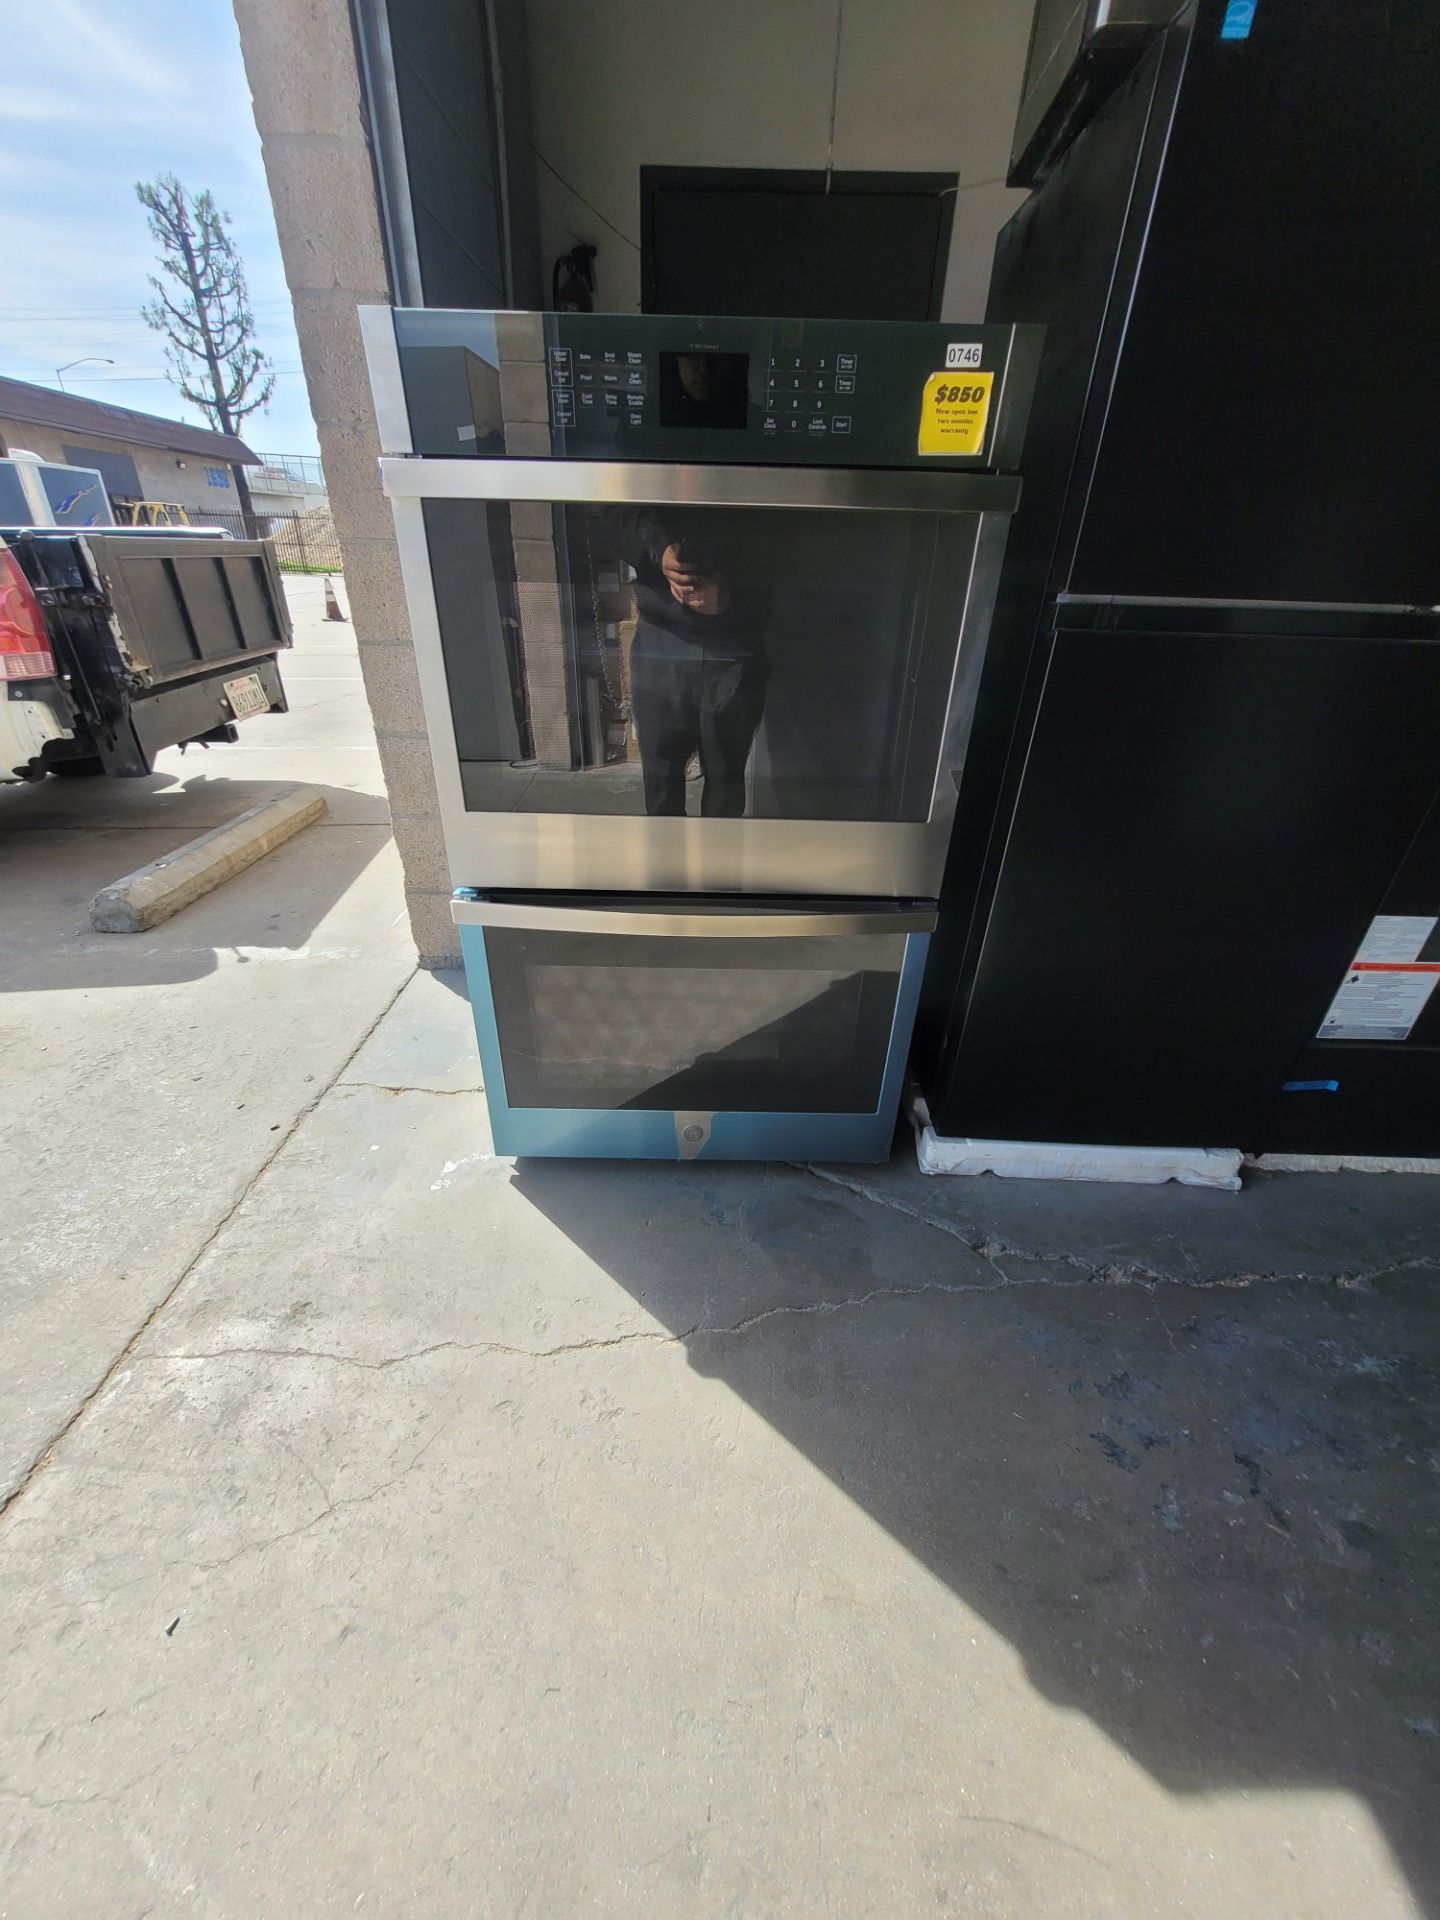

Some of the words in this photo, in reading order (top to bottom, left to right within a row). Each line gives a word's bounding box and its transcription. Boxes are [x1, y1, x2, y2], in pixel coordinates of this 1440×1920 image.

[948, 348, 980, 363] 0746
[771, 358, 775, 367] 1
[795, 358, 800, 367] 2
[820, 359, 825, 367] 3
[794, 380, 799, 388] 5
[818, 380, 823, 388] 6
[935, 384, 985, 405] $850
[769, 399, 774, 407] 7
[792, 399, 798, 408] 8
[816, 400, 822, 408] 9
[791, 420, 797, 428] 0
